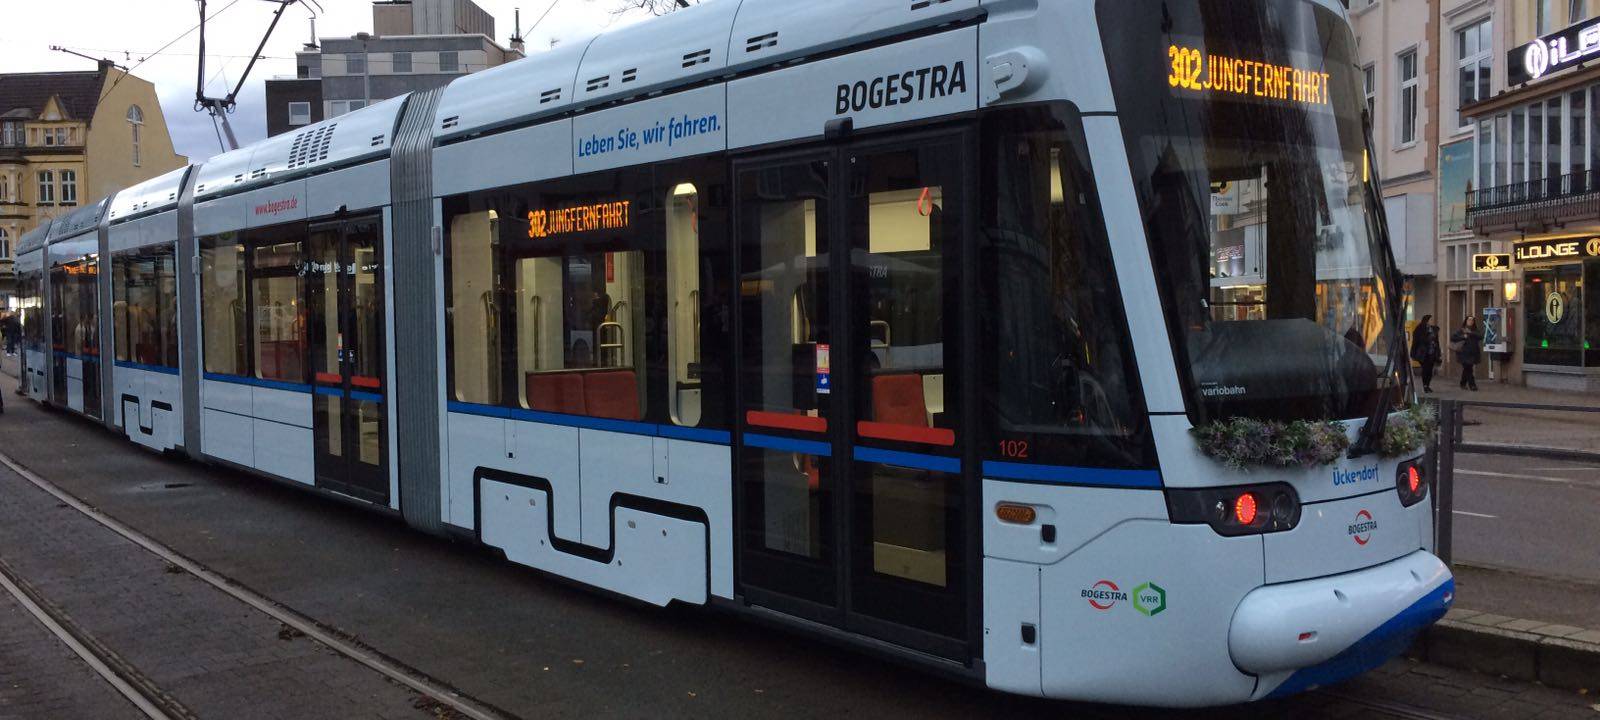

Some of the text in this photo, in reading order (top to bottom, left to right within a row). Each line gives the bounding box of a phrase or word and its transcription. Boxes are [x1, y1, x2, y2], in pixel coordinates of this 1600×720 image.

[1168, 44, 1330, 105] 302 JUNGFERNFAHRT
[835, 60, 967, 115] BOGESTRA
[578, 114, 721, 157] Leben Sie, wir fahren.
[527, 200, 630, 238] 302 JUNGFERNFAHRT
[1516, 241, 1580, 260] iLOUNGE
[1202, 385, 1247, 396] variobahn
[999, 439, 1029, 458] 102
[1332, 463, 1380, 486] Ückendorf
[1348, 520, 1378, 536] BOGESTRA
[1080, 589, 1129, 601] BOGESTRA
[1140, 595, 1159, 604] VRR
